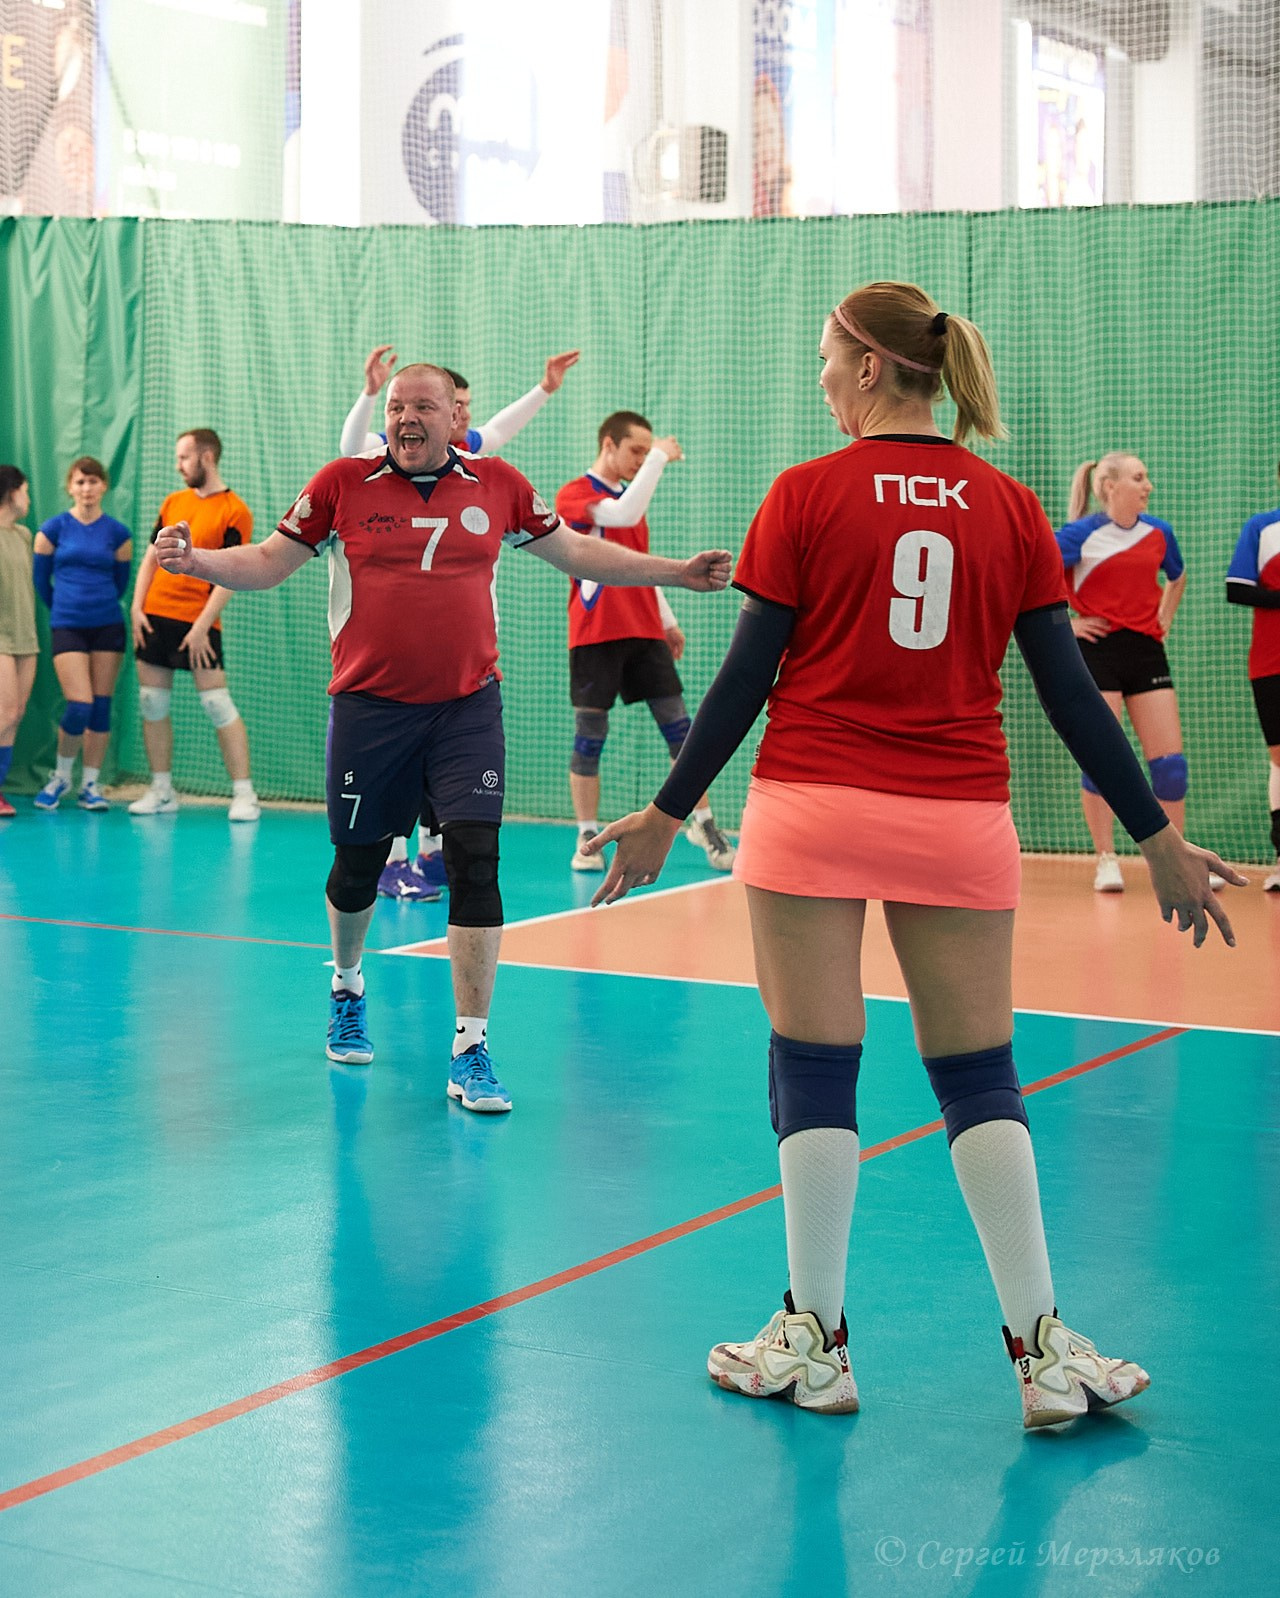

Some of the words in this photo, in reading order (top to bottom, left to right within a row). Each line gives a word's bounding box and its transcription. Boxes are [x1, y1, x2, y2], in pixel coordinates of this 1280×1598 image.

[873, 474, 970, 509] ПСК
[412, 517, 449, 571] 7
[888, 530, 954, 650] 9
[340, 793, 361, 829] 7
